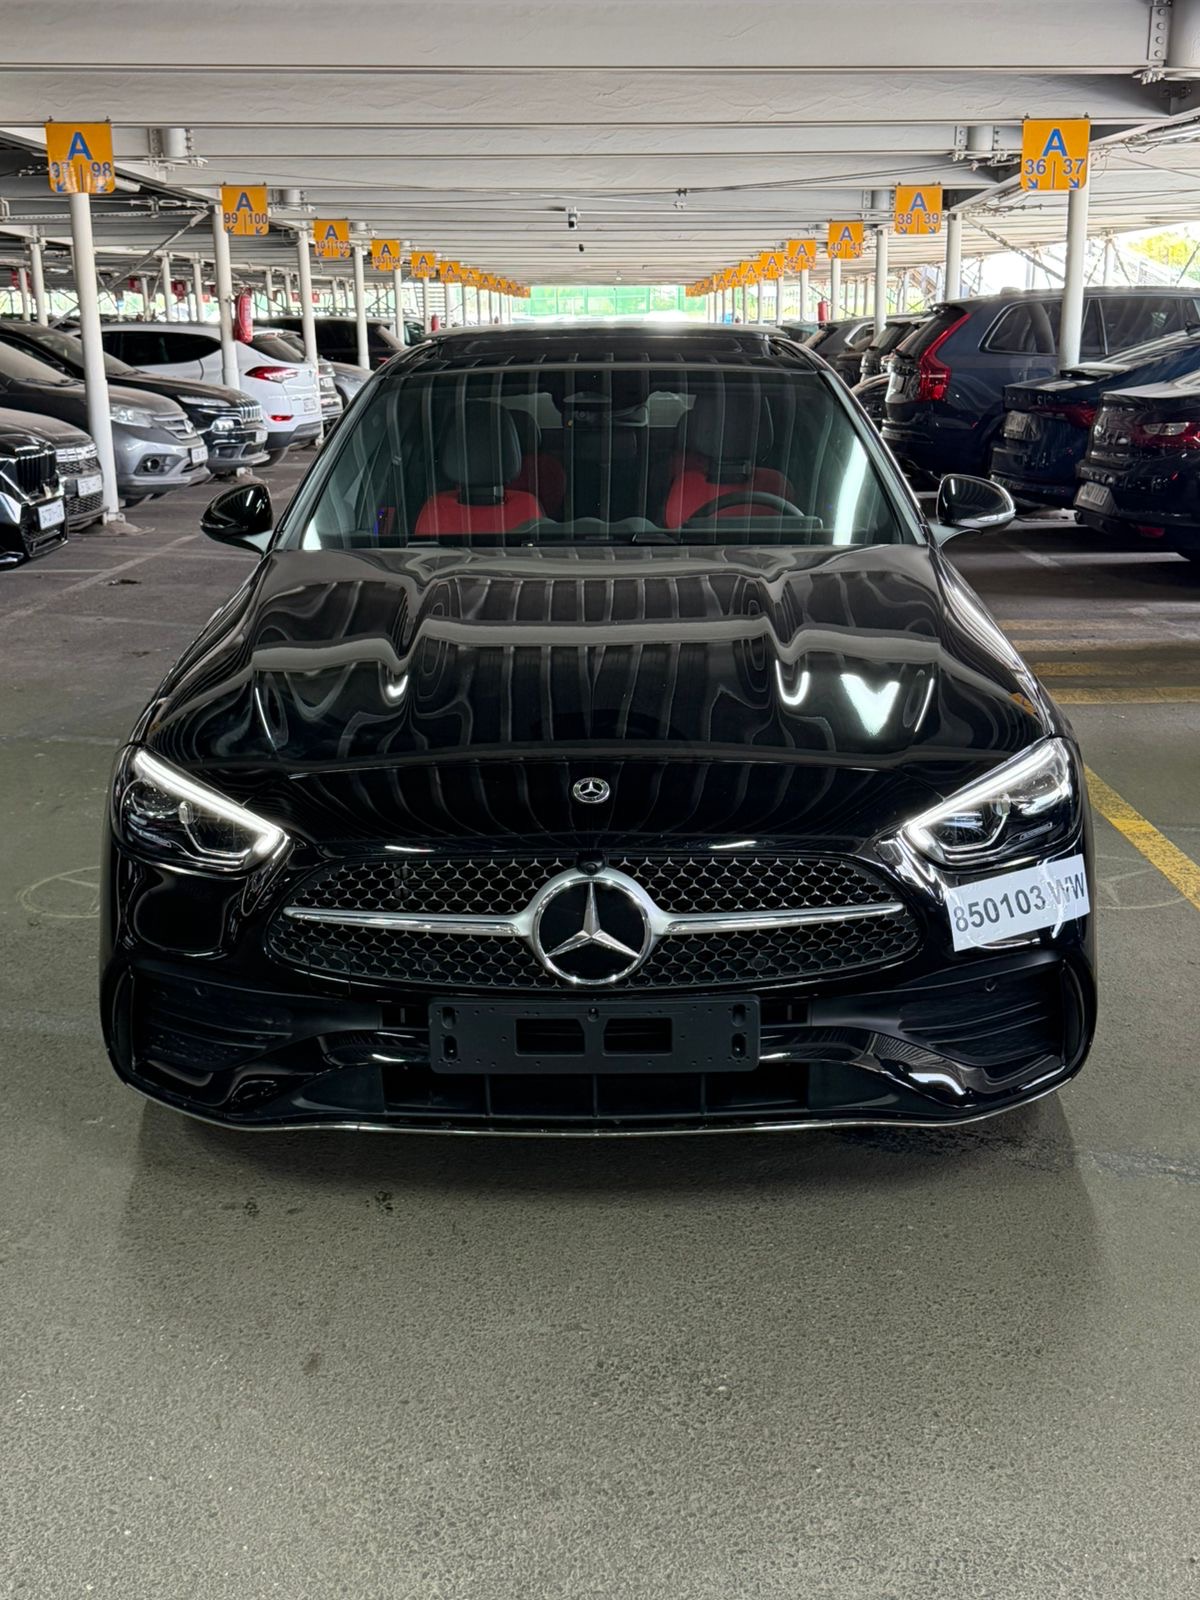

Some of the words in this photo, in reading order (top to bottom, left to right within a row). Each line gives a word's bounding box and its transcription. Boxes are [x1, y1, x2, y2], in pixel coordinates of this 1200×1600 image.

[67, 131, 93, 160] A
[1042, 128, 1067, 157] A
[91, 162, 112, 178] 98
[1025, 159, 1046, 175] 36
[1063, 159, 1085, 174] 37
[236, 192, 253, 211] A
[910, 192, 927, 211] A
[224, 213, 238, 223] 99
[248, 213, 268, 224] 100
[898, 213, 912, 224] 38
[924, 213, 939, 224] 39
[325, 224, 339, 240] A
[840, 226, 852, 241] A
[381, 244, 392, 256] A
[797, 244, 807, 256] A
[830, 243, 842, 251] 40
[419, 255, 429, 266] A
[768, 255, 778, 266] A
[447, 264, 455, 273] A
[747, 264, 756, 273] A
[731, 271, 739, 279] A
[953, 885, 1046, 932] 850103
[1047, 872, 1085, 905] WW
